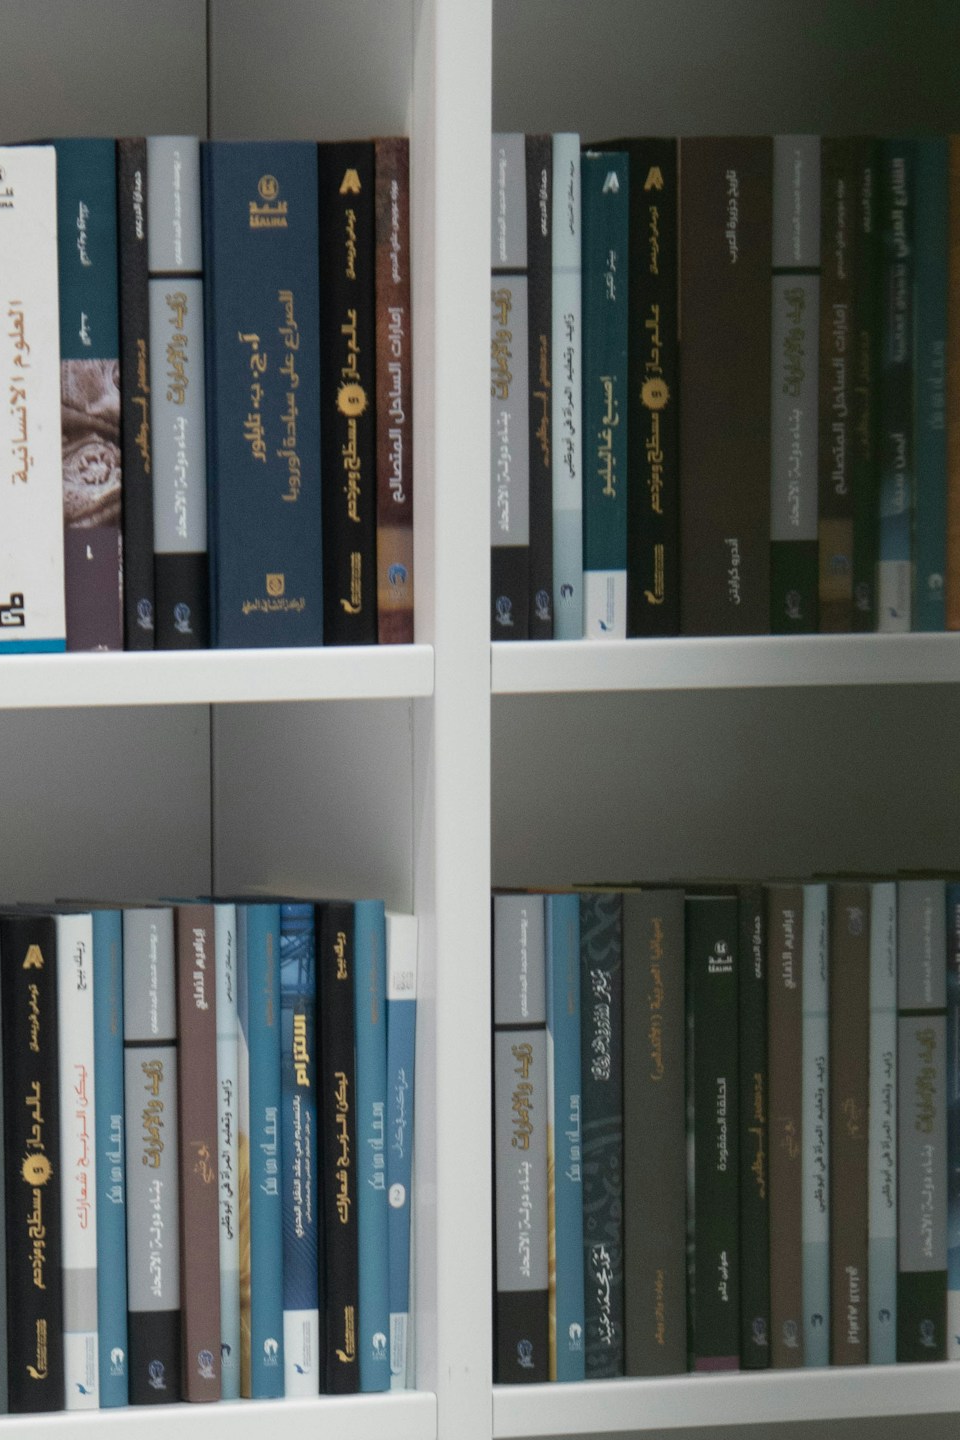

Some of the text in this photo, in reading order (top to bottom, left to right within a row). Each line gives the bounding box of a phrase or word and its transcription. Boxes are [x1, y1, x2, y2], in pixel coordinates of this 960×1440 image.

[8, 301, 30, 368] العلوم
[279, 290, 299, 350] الصراع
[280, 353, 299, 388] على
[389, 363, 404, 424] الساحل
[281, 393, 298, 447] سيادة
[389, 429, 405, 503] المتصالح
[294, 1015, 310, 1086] الالتزام
